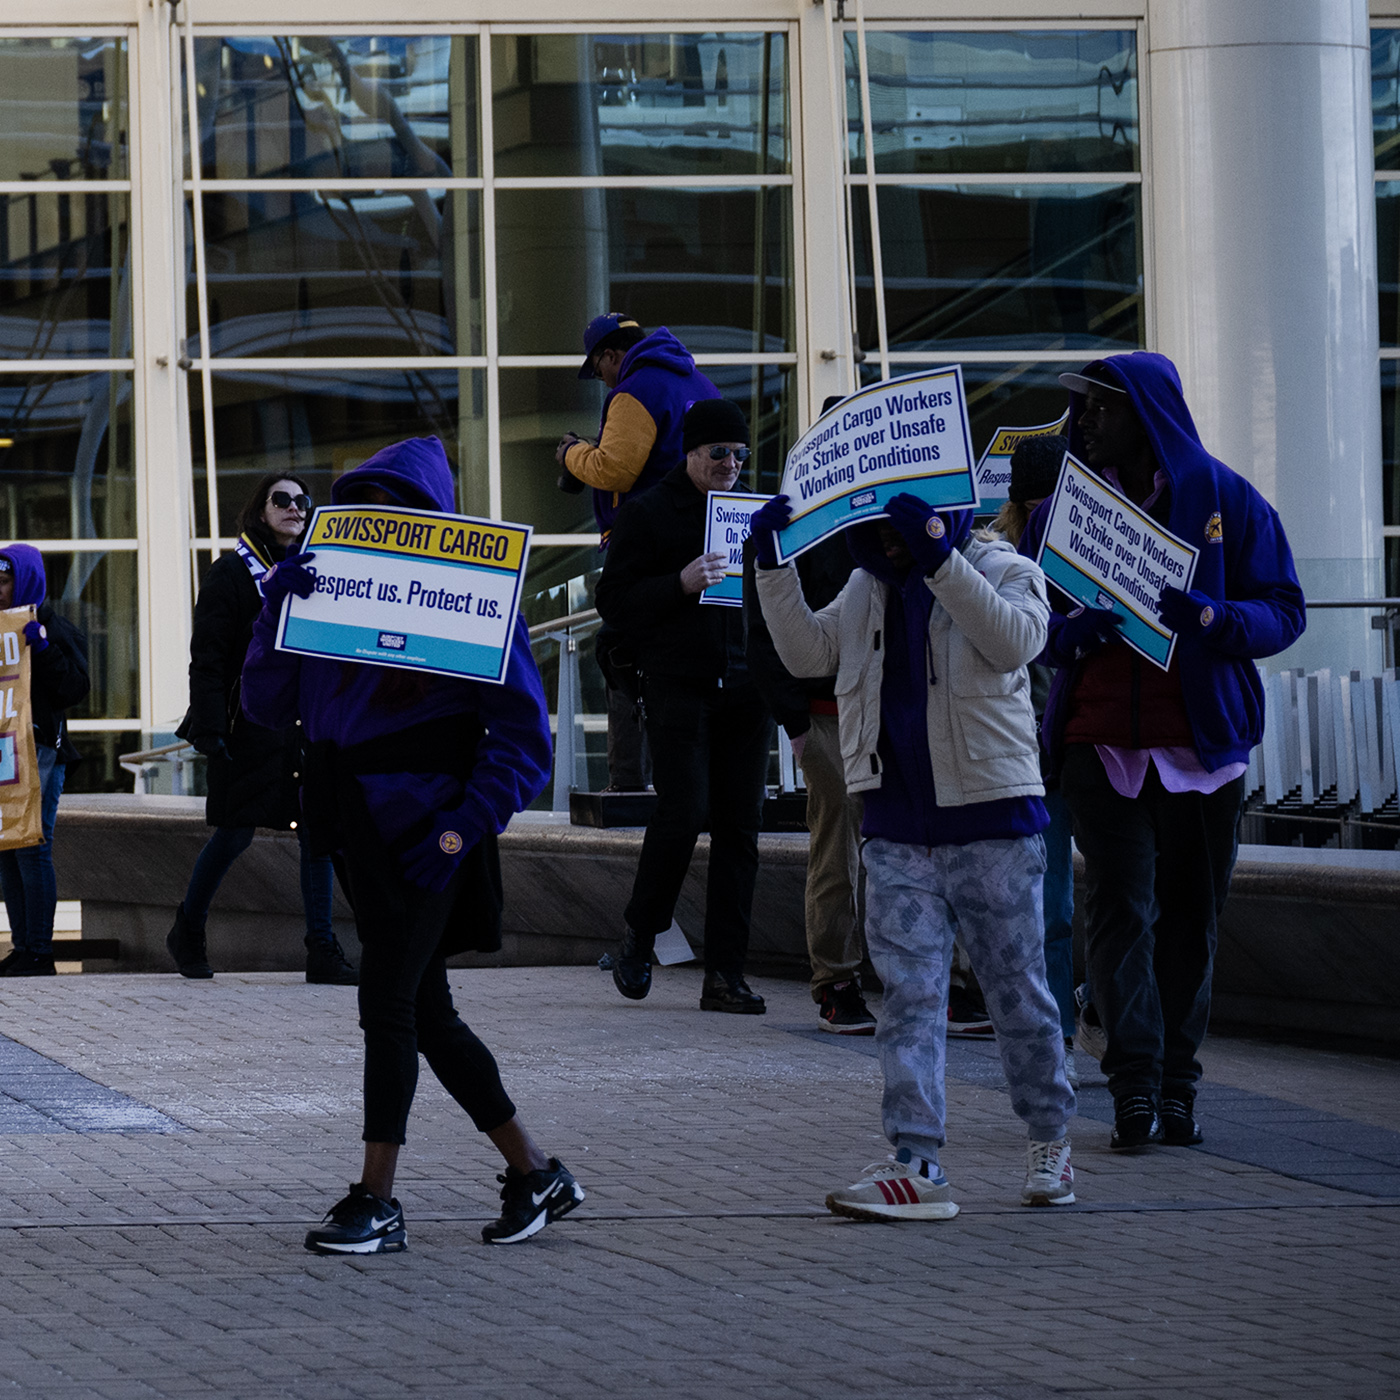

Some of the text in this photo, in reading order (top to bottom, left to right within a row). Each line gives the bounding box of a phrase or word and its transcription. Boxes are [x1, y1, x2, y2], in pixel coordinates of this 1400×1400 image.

[789, 390, 952, 470] Swissport Cargo Workers
[794, 413, 946, 481] On Strike over Unsafe
[800, 464, 855, 500] Working
[859, 444, 940, 474] Conditions
[979, 469, 1011, 487] Respe
[322, 516, 509, 562] SWISSPORT CARGO
[716, 507, 750, 528] Swissp
[725, 527, 738, 544] On
[1065, 475, 1184, 577] Swissport Cargo Workers
[1069, 504, 1083, 528] On
[1084, 517, 1113, 551] Strike
[1114, 543, 1137, 567] over
[377, 583, 402, 604] us.
[407, 580, 473, 614] Protect
[477, 598, 502, 620] us.
[1069, 530, 1159, 615] Working Conditions
